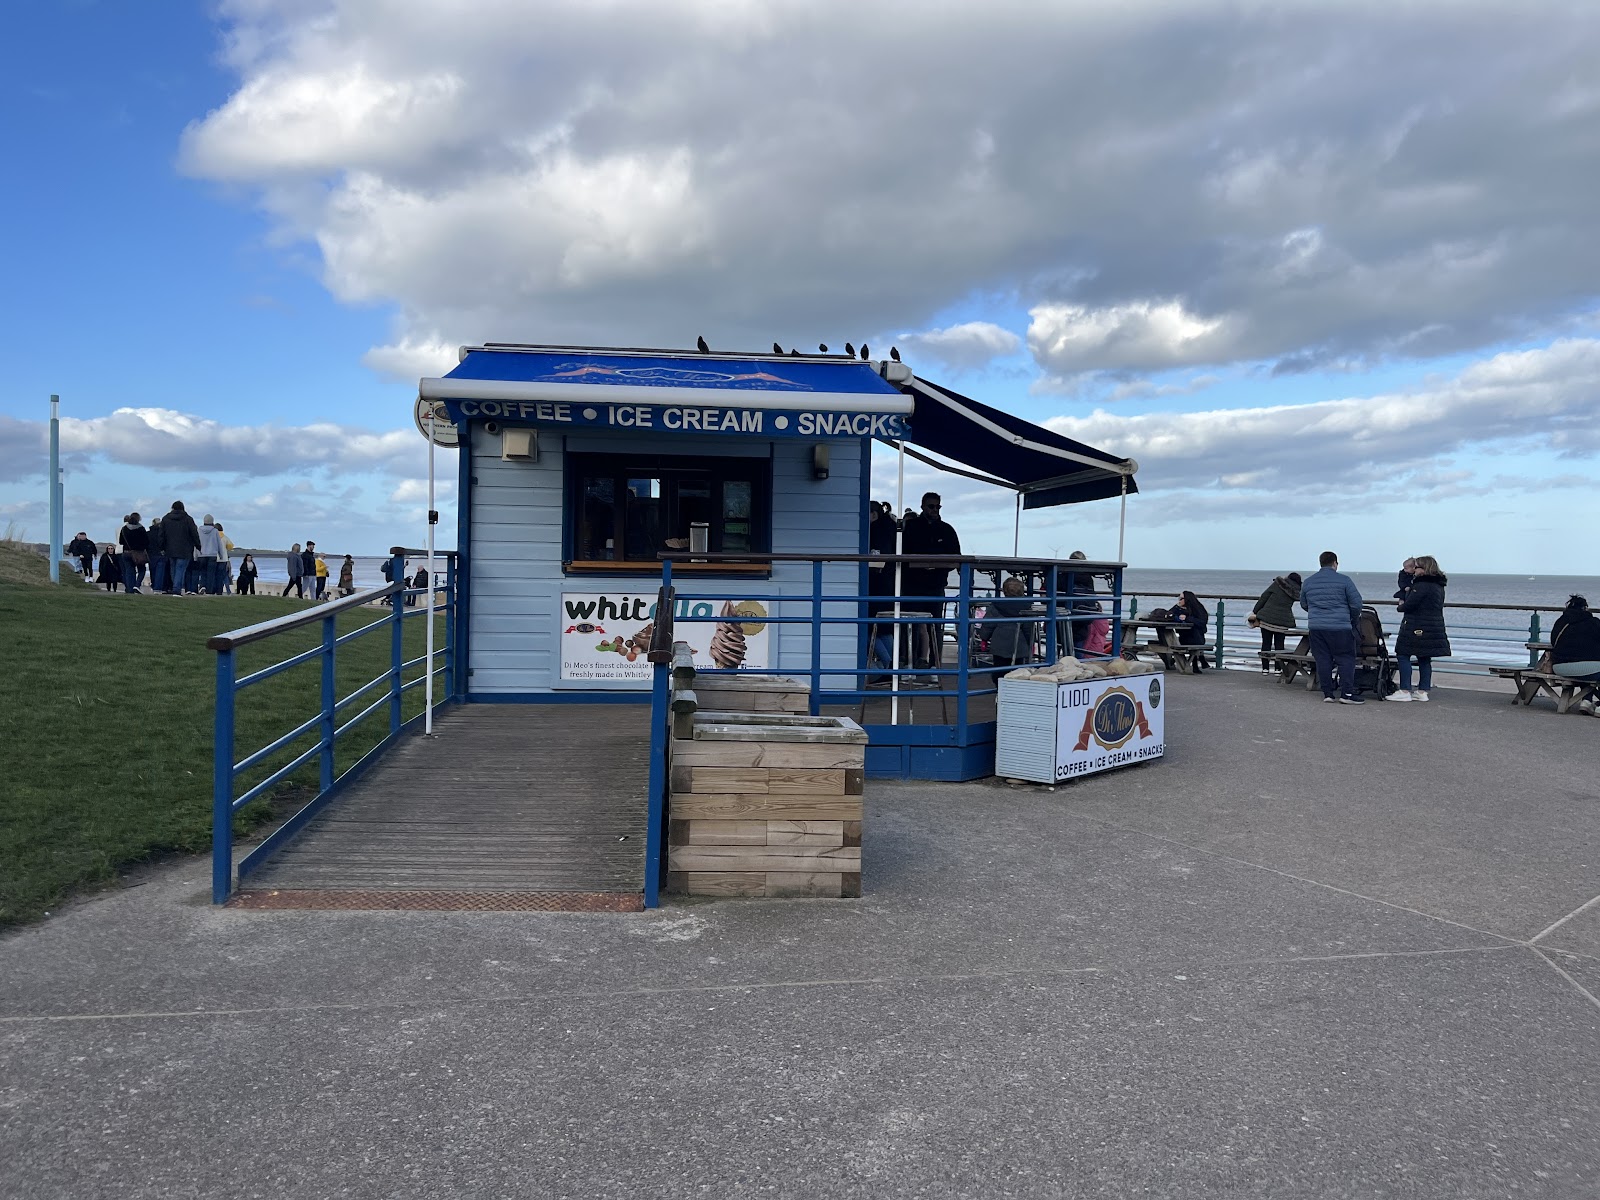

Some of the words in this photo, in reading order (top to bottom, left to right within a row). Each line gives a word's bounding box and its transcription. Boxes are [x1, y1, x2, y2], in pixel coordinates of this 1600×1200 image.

[460, 400, 572, 422] COFFEE
[608, 406, 653, 427] ICE
[663, 408, 763, 433] CREAM
[797, 413, 902, 437] SNACKS
[570, 671, 594, 679] freshly
[624, 671, 651, 679] Whitley
[595, 661, 614, 669] finest
[616, 661, 649, 669] chocolate
[1062, 688, 1090, 708] LIDO
[1057, 761, 1087, 777] COFFEE
[1095, 756, 1106, 769] ICE
[1109, 750, 1132, 765] CREAM
[1139, 744, 1163, 758] SNACKS
